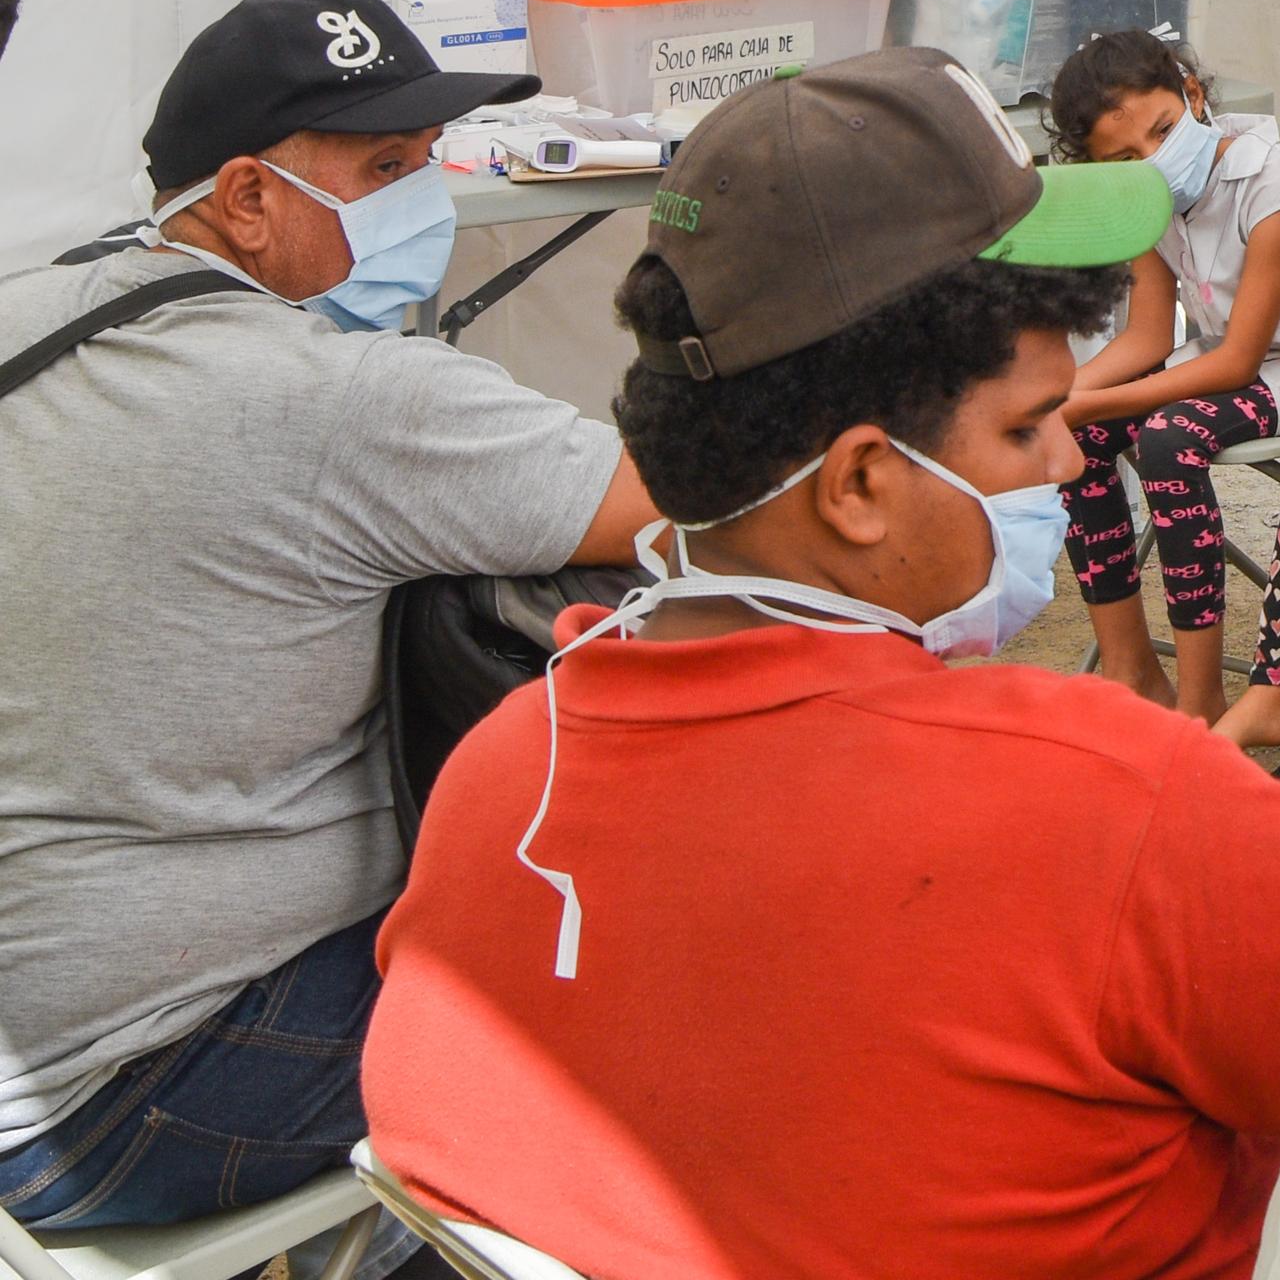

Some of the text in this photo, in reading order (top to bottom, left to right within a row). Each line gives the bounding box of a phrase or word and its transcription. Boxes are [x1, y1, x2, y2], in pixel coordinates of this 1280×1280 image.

[656, 35, 793, 71] SOLO PARA CAJA DE
